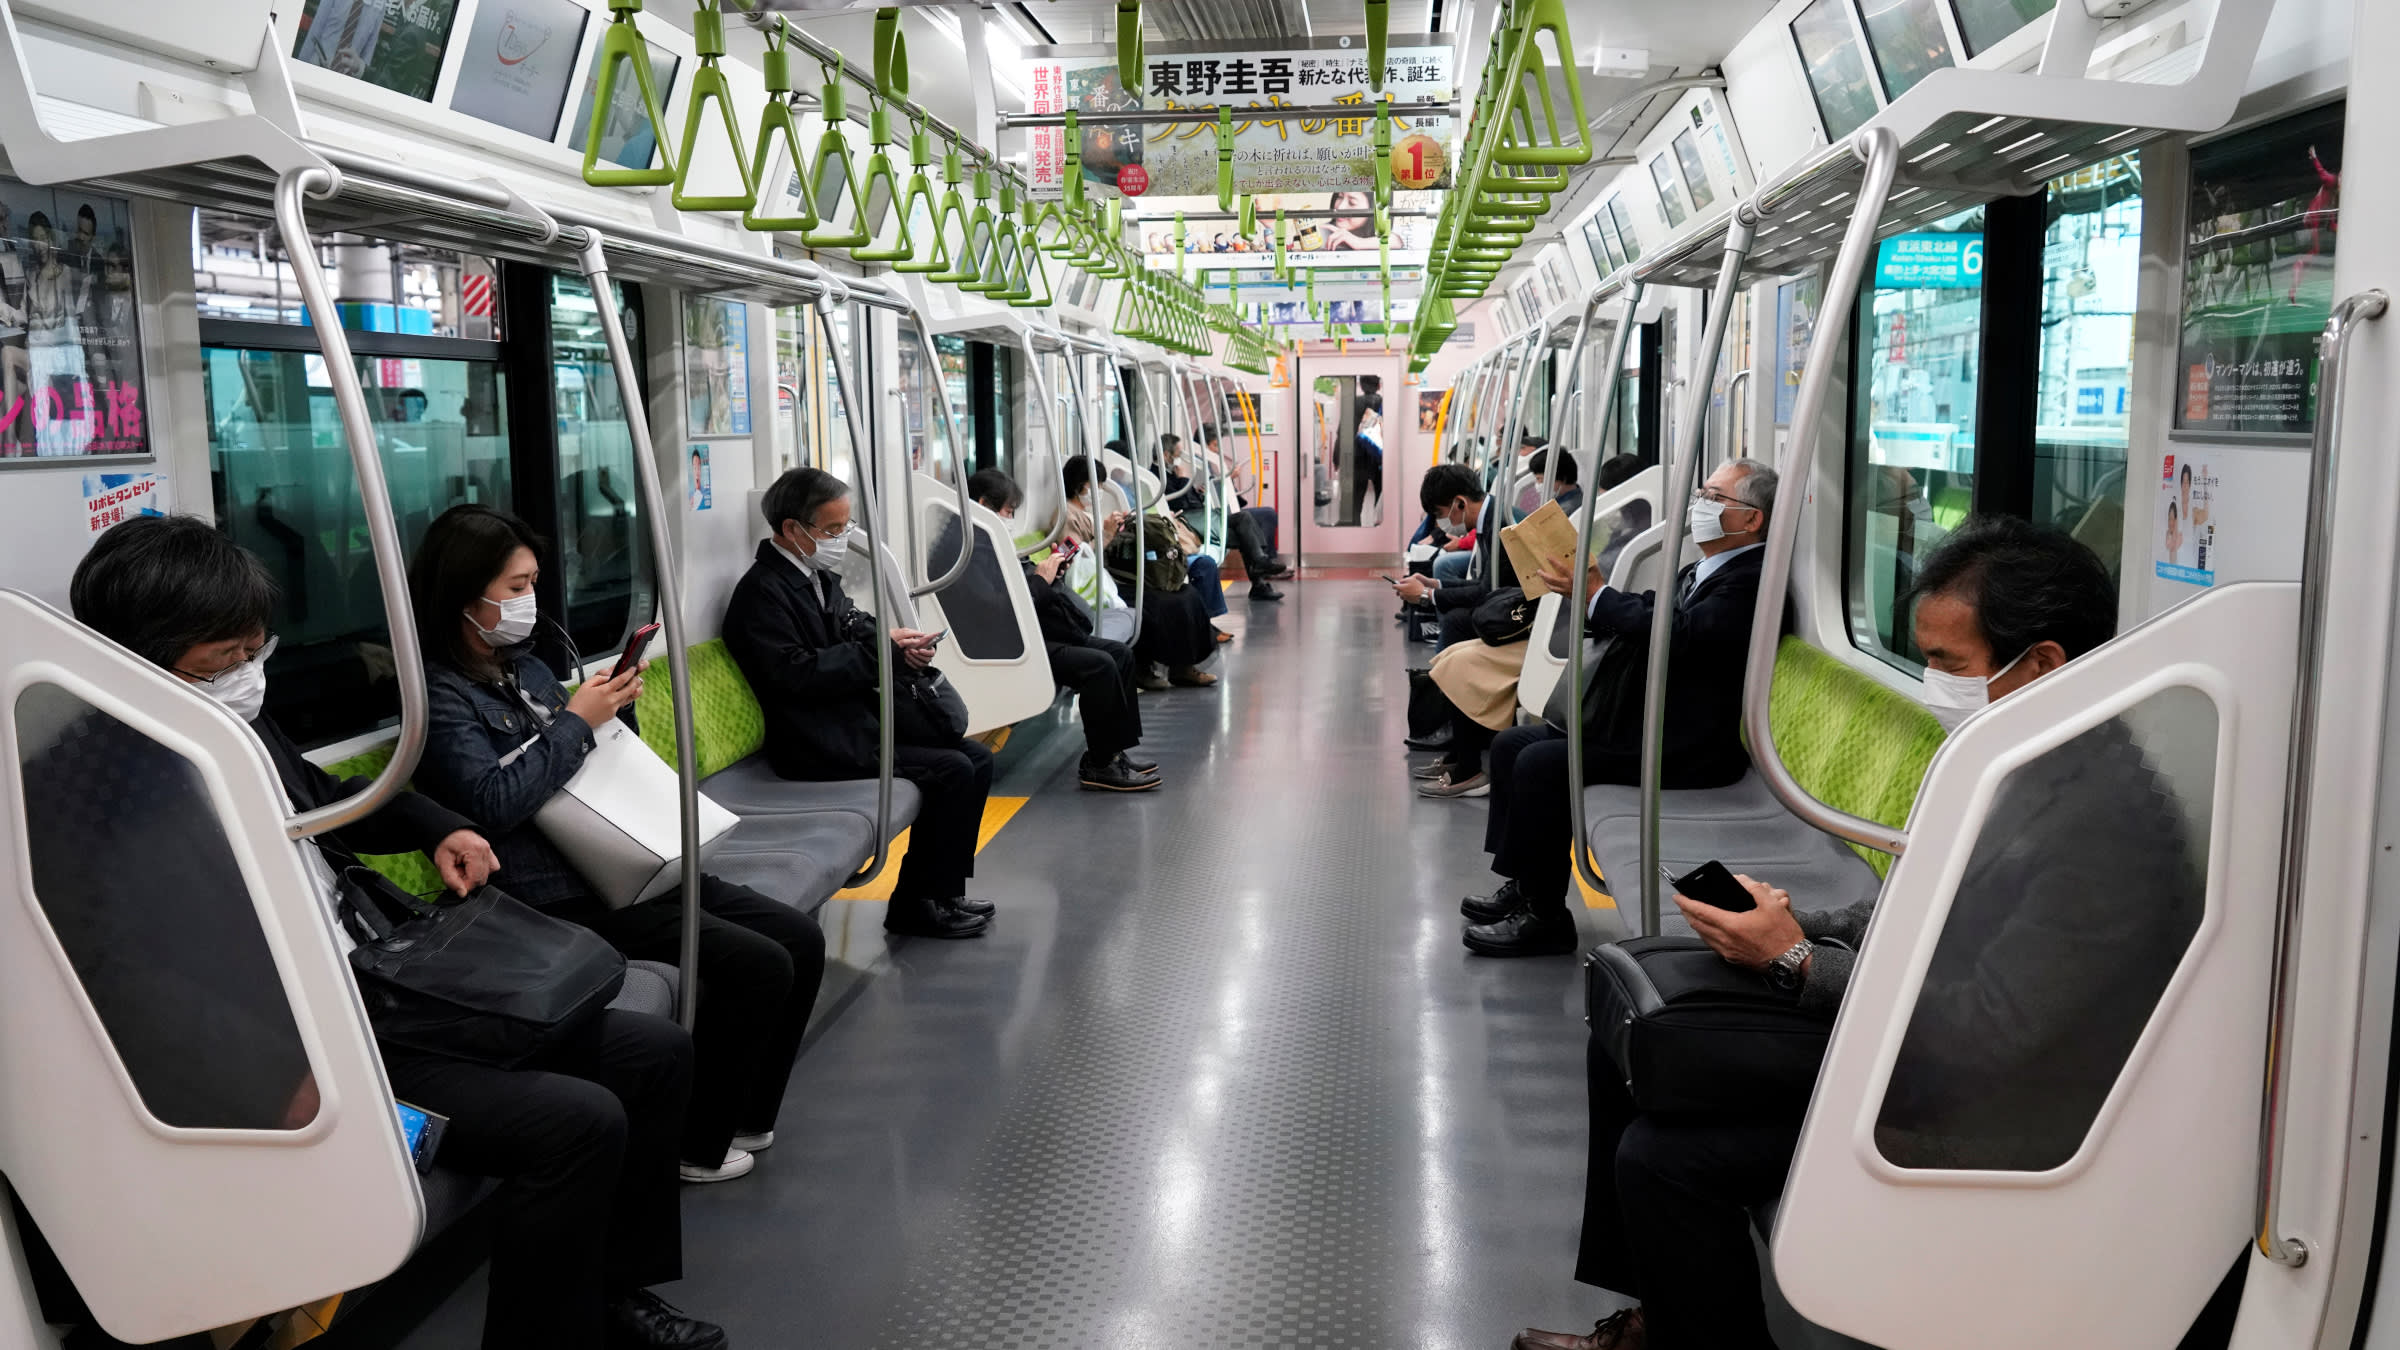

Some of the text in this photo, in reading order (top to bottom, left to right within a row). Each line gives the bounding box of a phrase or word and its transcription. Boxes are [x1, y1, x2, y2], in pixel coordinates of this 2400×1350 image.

[1149, 58, 1294, 97] 東野圭吾
[1233, 146, 1376, 163] の木に祈れば、願いが叶
[1962, 240, 1982, 274] 6
[89, 480, 156, 512] リポビタンゼリー
[90, 505, 124, 532] 新登場!
